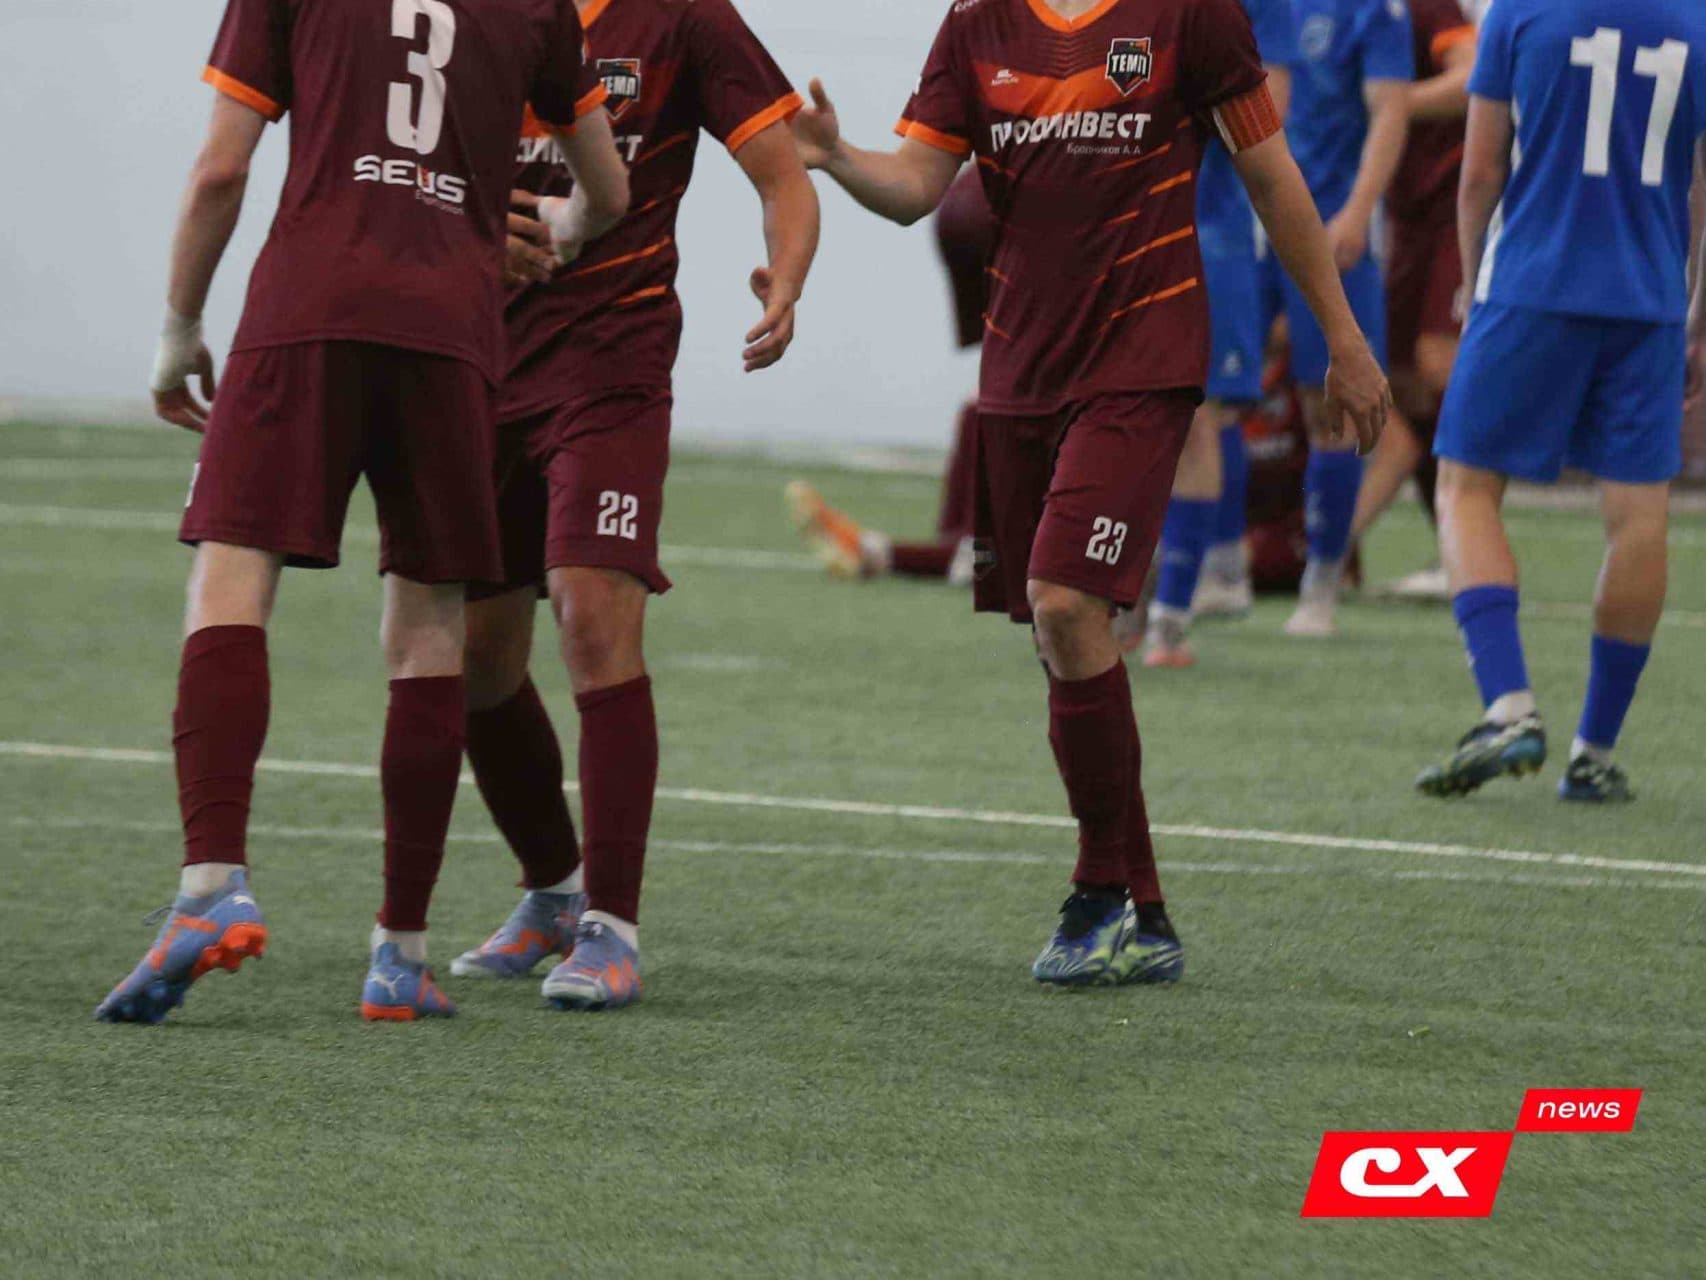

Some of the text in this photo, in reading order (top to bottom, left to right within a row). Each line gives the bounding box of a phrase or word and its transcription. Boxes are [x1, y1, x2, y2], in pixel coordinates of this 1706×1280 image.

[1111, 53, 1147, 76] ТЕМП
[1569, 26, 1689, 186] 11
[597, 490, 639, 540] 22
[1085, 515, 1128, 566] 23
